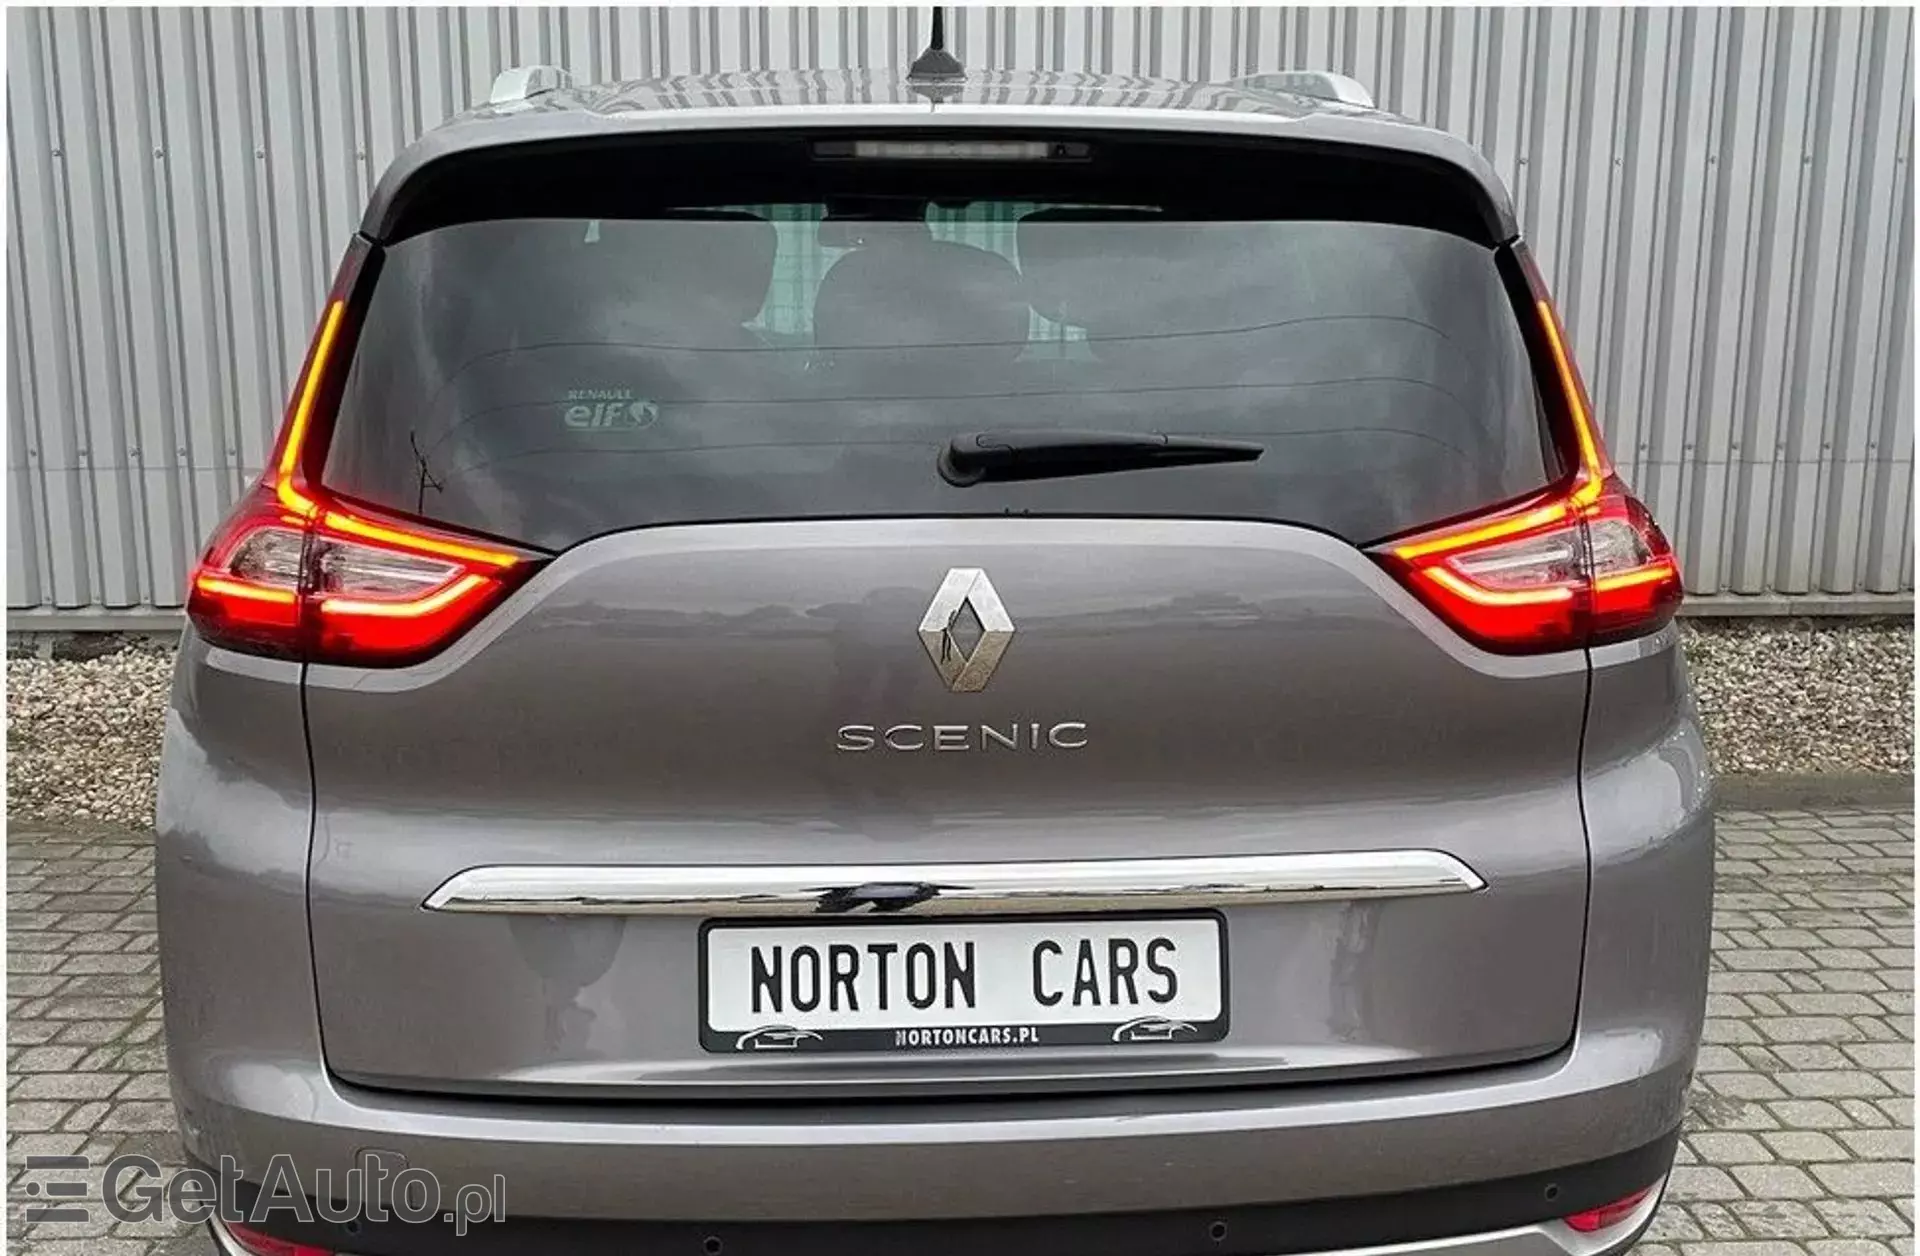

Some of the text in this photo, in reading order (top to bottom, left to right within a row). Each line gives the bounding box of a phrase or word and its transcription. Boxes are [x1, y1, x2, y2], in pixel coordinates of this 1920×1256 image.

[836, 723, 1088, 751] SCENIC
[750, 937, 1178, 1013] NORTON CARS
[895, 1026, 1039, 1046] NORTONCARS.PL
